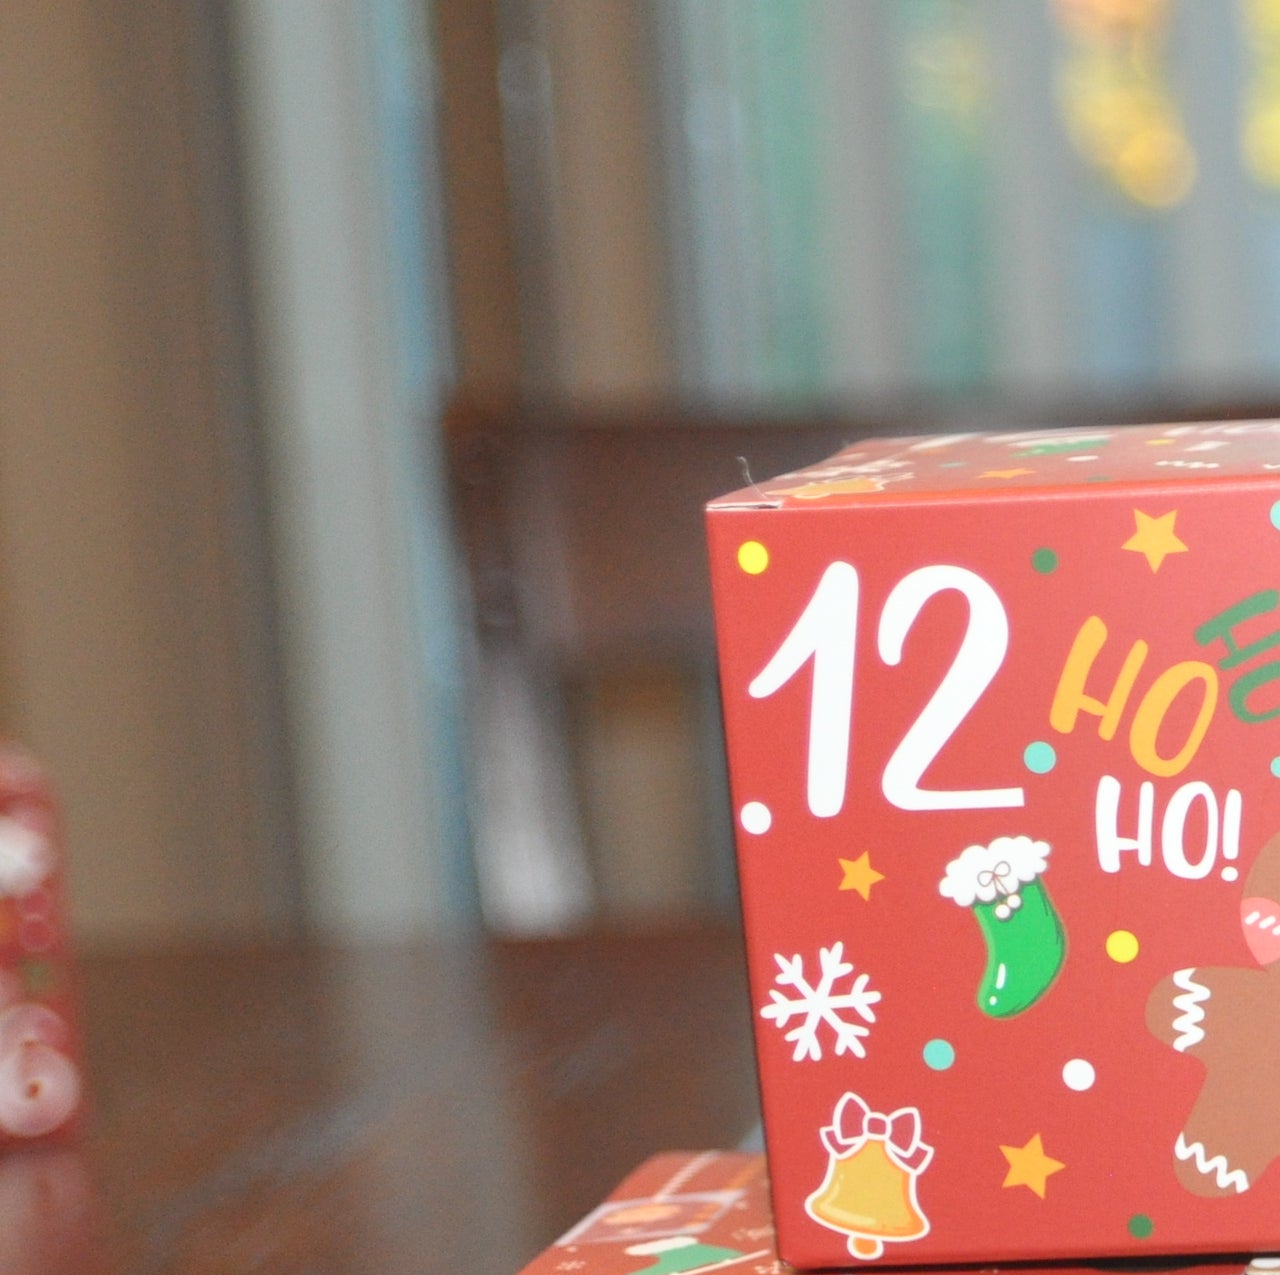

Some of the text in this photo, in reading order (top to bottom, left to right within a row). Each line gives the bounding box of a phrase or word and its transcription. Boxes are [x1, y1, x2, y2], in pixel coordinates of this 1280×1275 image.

[748, 560, 1024, 818] 12
[1049, 615, 1219, 778] HO
[1094, 774, 1243, 882] HO!
